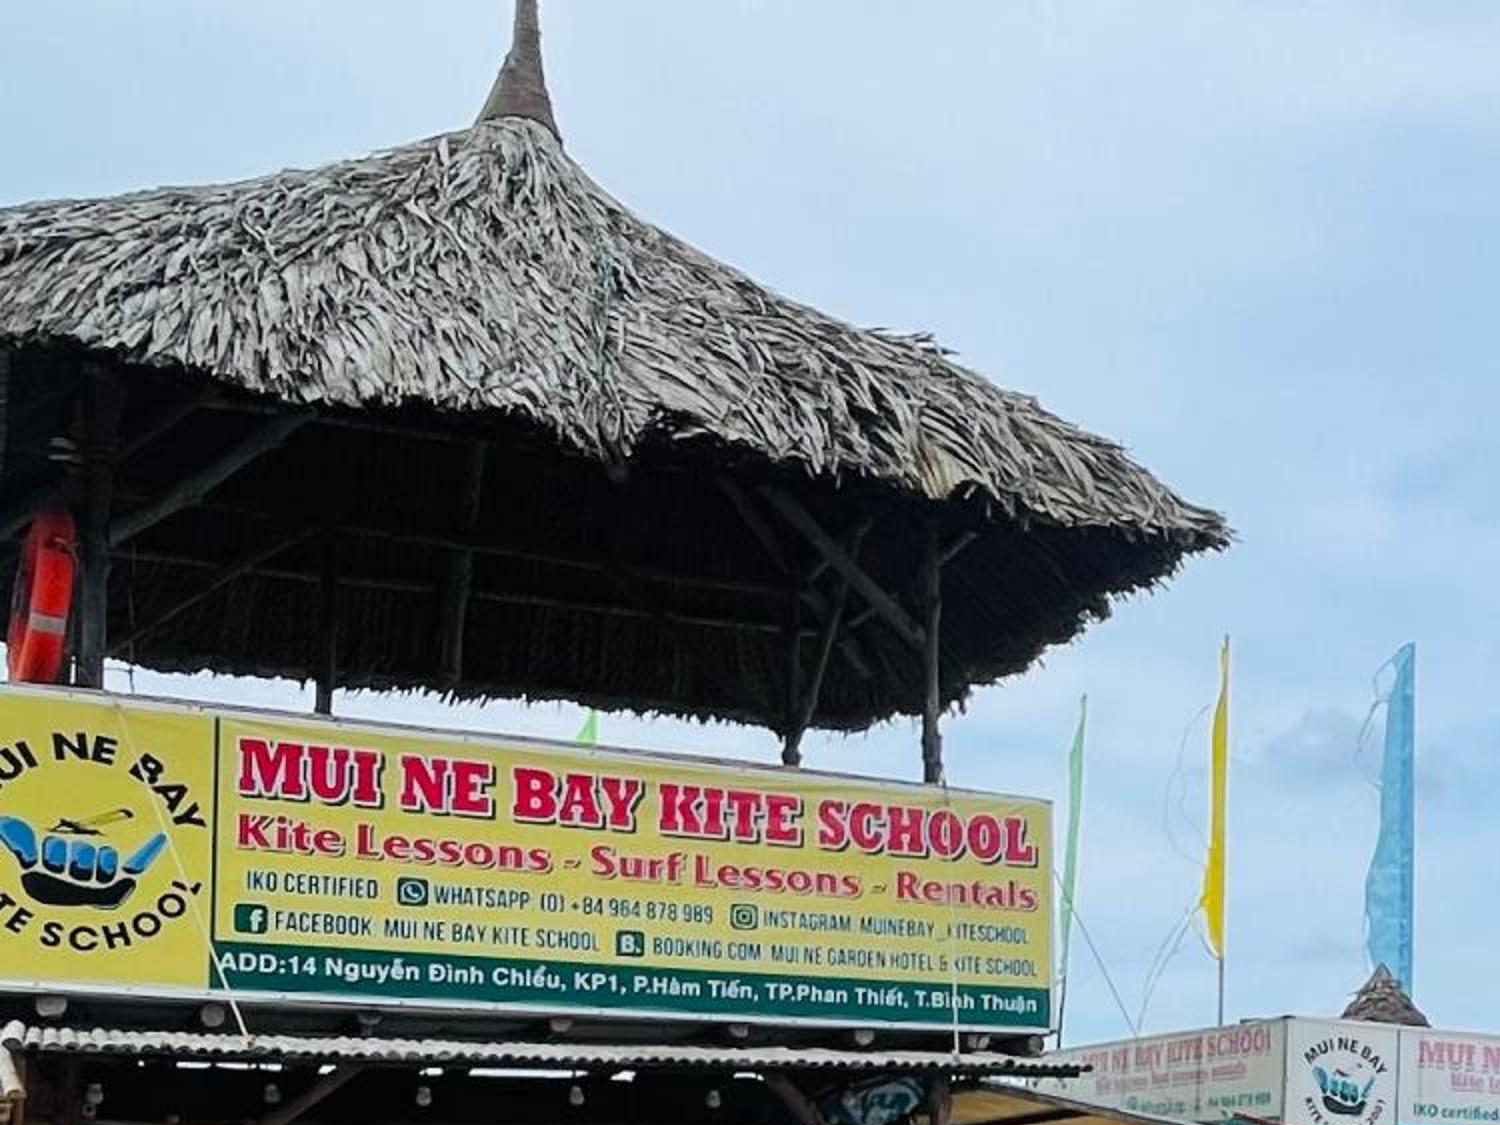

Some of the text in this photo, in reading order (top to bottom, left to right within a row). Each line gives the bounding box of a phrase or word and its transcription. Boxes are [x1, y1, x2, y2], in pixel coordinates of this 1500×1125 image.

[0, 732, 207, 828] UI NE BAY
[238, 738, 1038, 867] MUI NE BAY KITE SCHOOL
[237, 814, 345, 858] Kite
[356, 823, 553, 874] Lessons
[591, 845, 686, 886] Surf
[694, 853, 863, 898] Lessons
[896, 870, 1038, 911] Rentals
[246, 869, 277, 892] IKO
[0, 880, 202, 951] TE SCHOOL
[646, 902, 678, 922] 878
[683, 904, 714, 924] 989
[384, 918, 418, 940] MUI
[423, 920, 445, 942] NE
[451, 922, 488, 944] BAY
[493, 926, 532, 947] KITE
[536, 928, 600, 952] SCHOOL
[771, 944, 800, 964] MUI
[803, 946, 823, 966] NE
[827, 949, 886, 969] GARDEN
[890, 952, 934, 973] HOTEL
[985, 957, 1038, 977] SCHOOL
[574, 972, 627, 996] KP1,
[1304, 1037, 1388, 1074] MUI NE BAY
[1418, 1040, 1475, 1071] MUI
